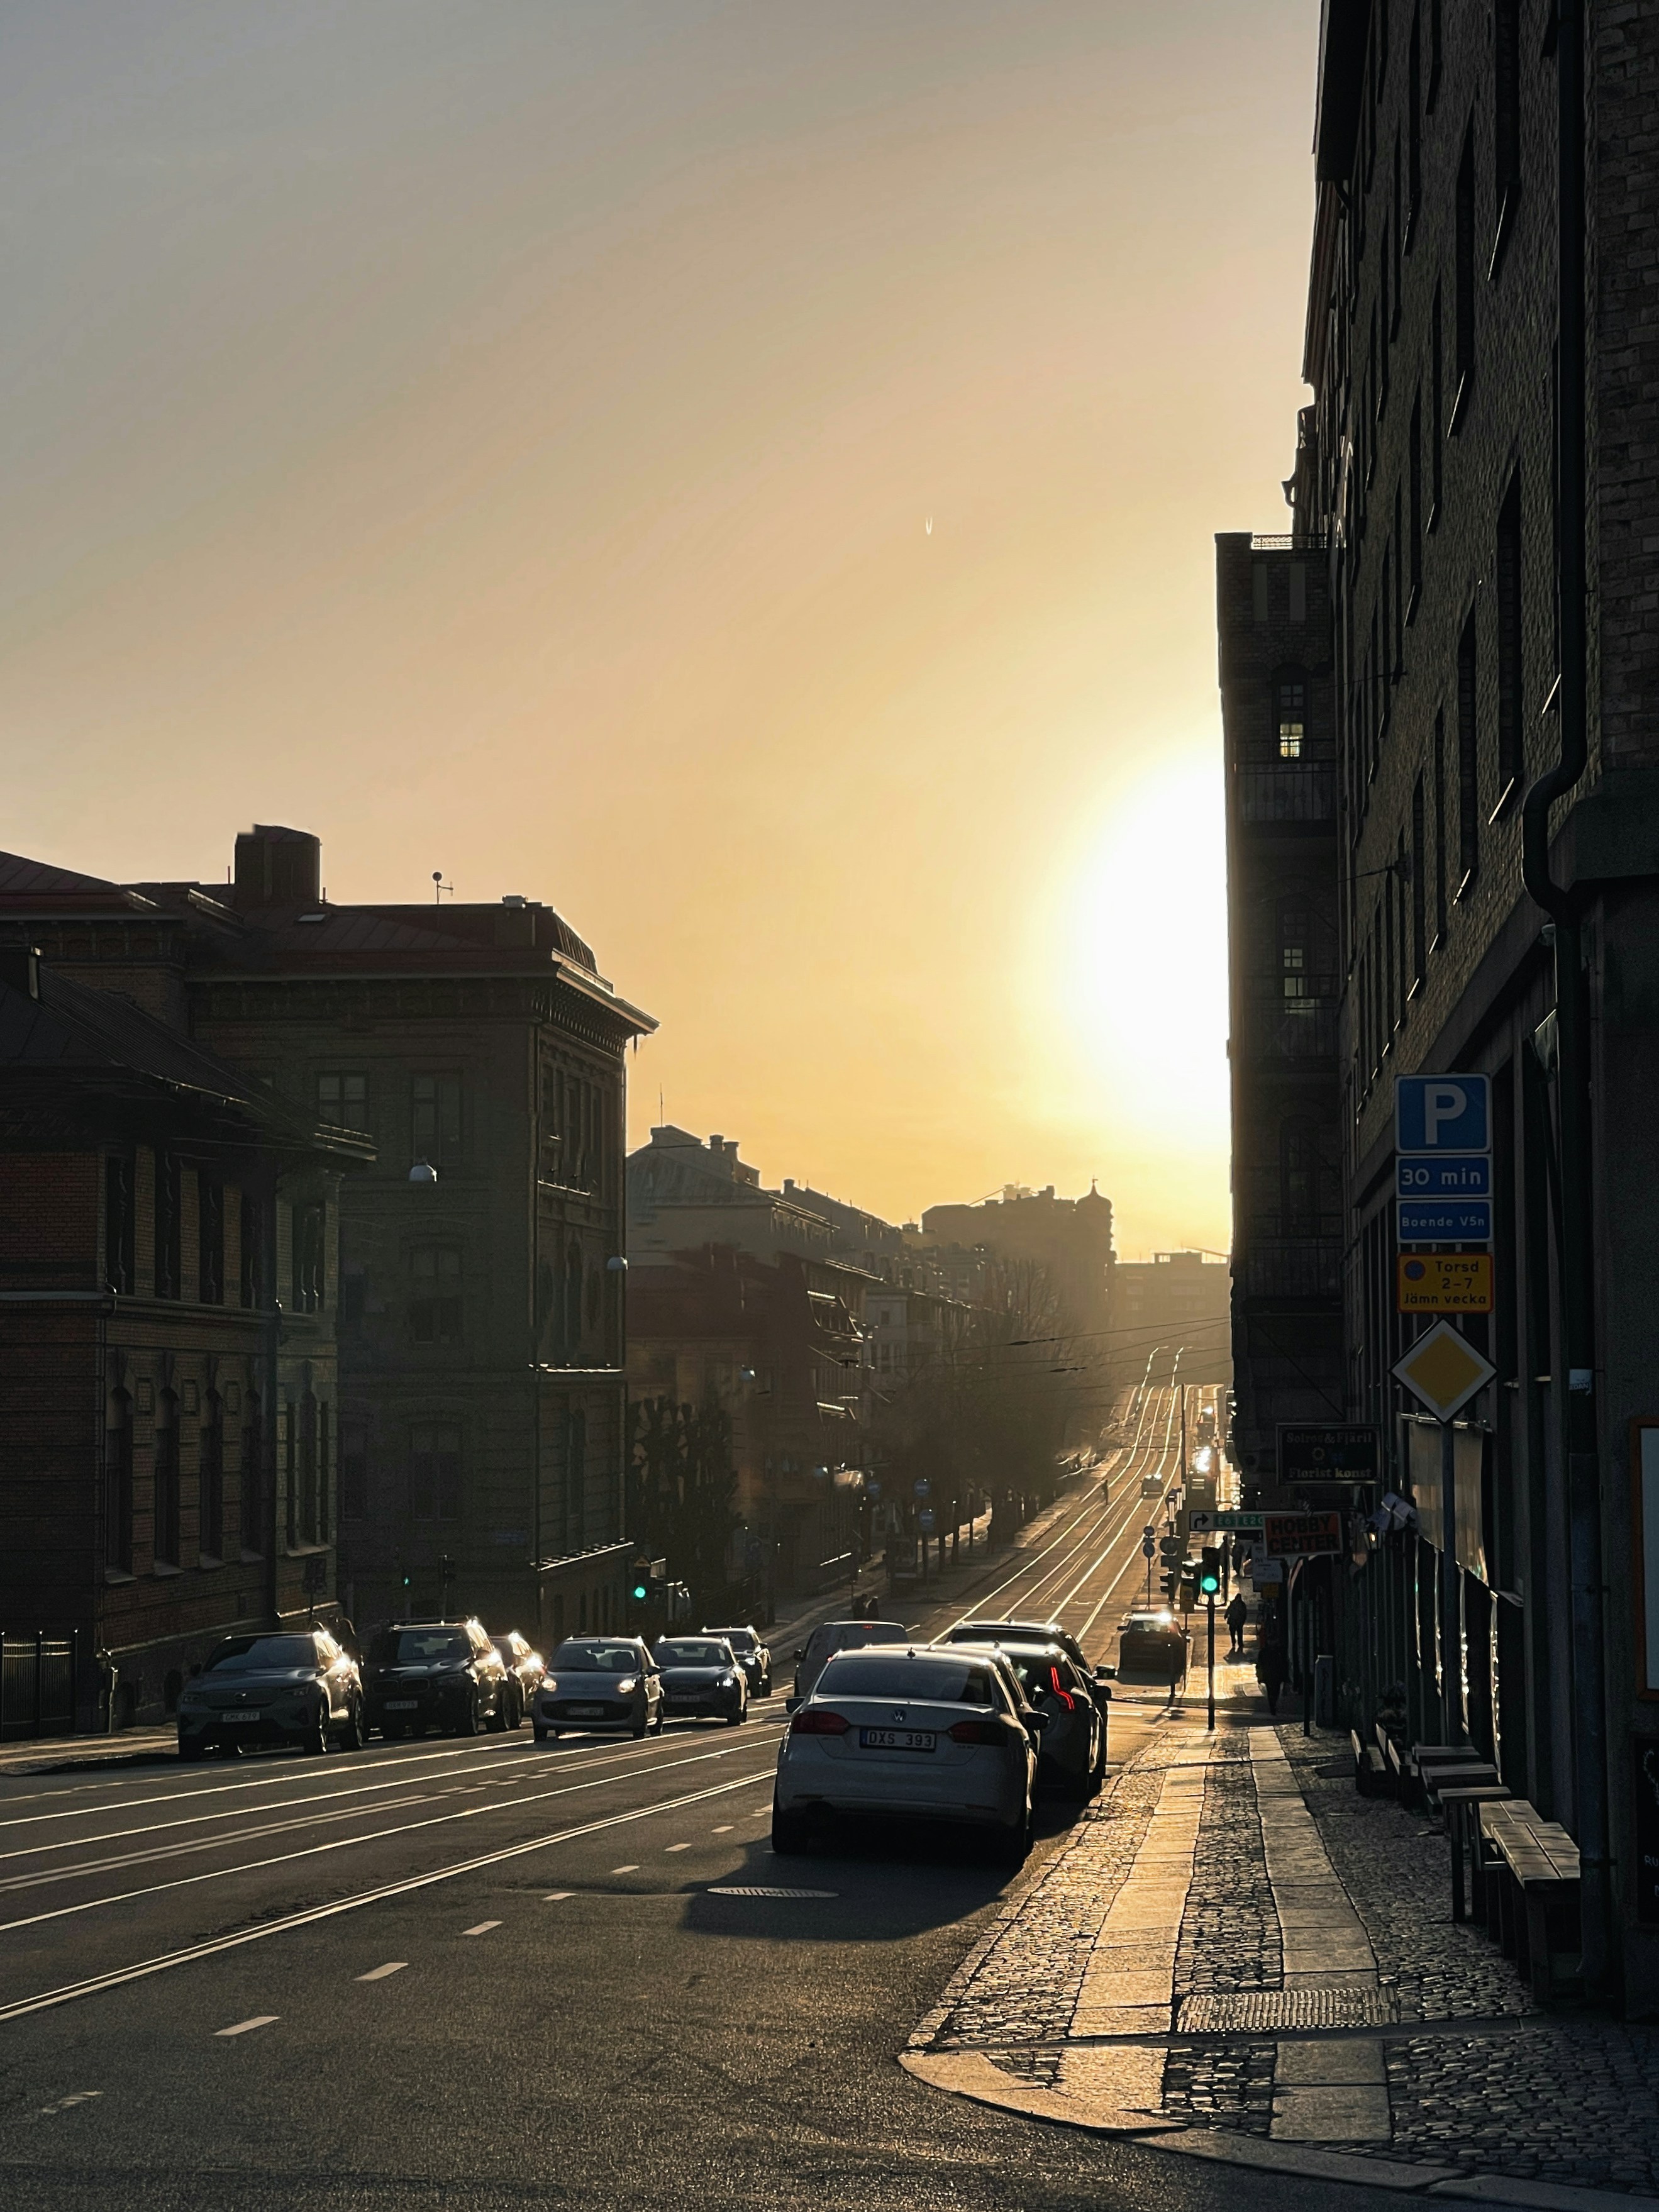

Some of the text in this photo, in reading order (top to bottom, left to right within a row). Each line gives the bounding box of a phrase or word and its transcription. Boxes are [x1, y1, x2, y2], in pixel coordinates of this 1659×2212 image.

[1424, 1084, 1467, 1145] P
[1401, 1167, 1481, 1186] 30 min
[1401, 1216, 1485, 1226] Boende V5n
[1435, 1260, 1479, 1272] Torsd
[1404, 1293, 1486, 1304] Jämn vecka
[1324, 1433, 1335, 1444] &
[1337, 1432, 1373, 1445] Fjäril
[1289, 1467, 1372, 1478] Florist konst
[1218, 1516, 1232, 1525] E6
[1271, 1515, 1331, 1535] HOBBY
[1269, 1534, 1339, 1552] CENTER
[869, 1731, 932, 1747] DXS 393
